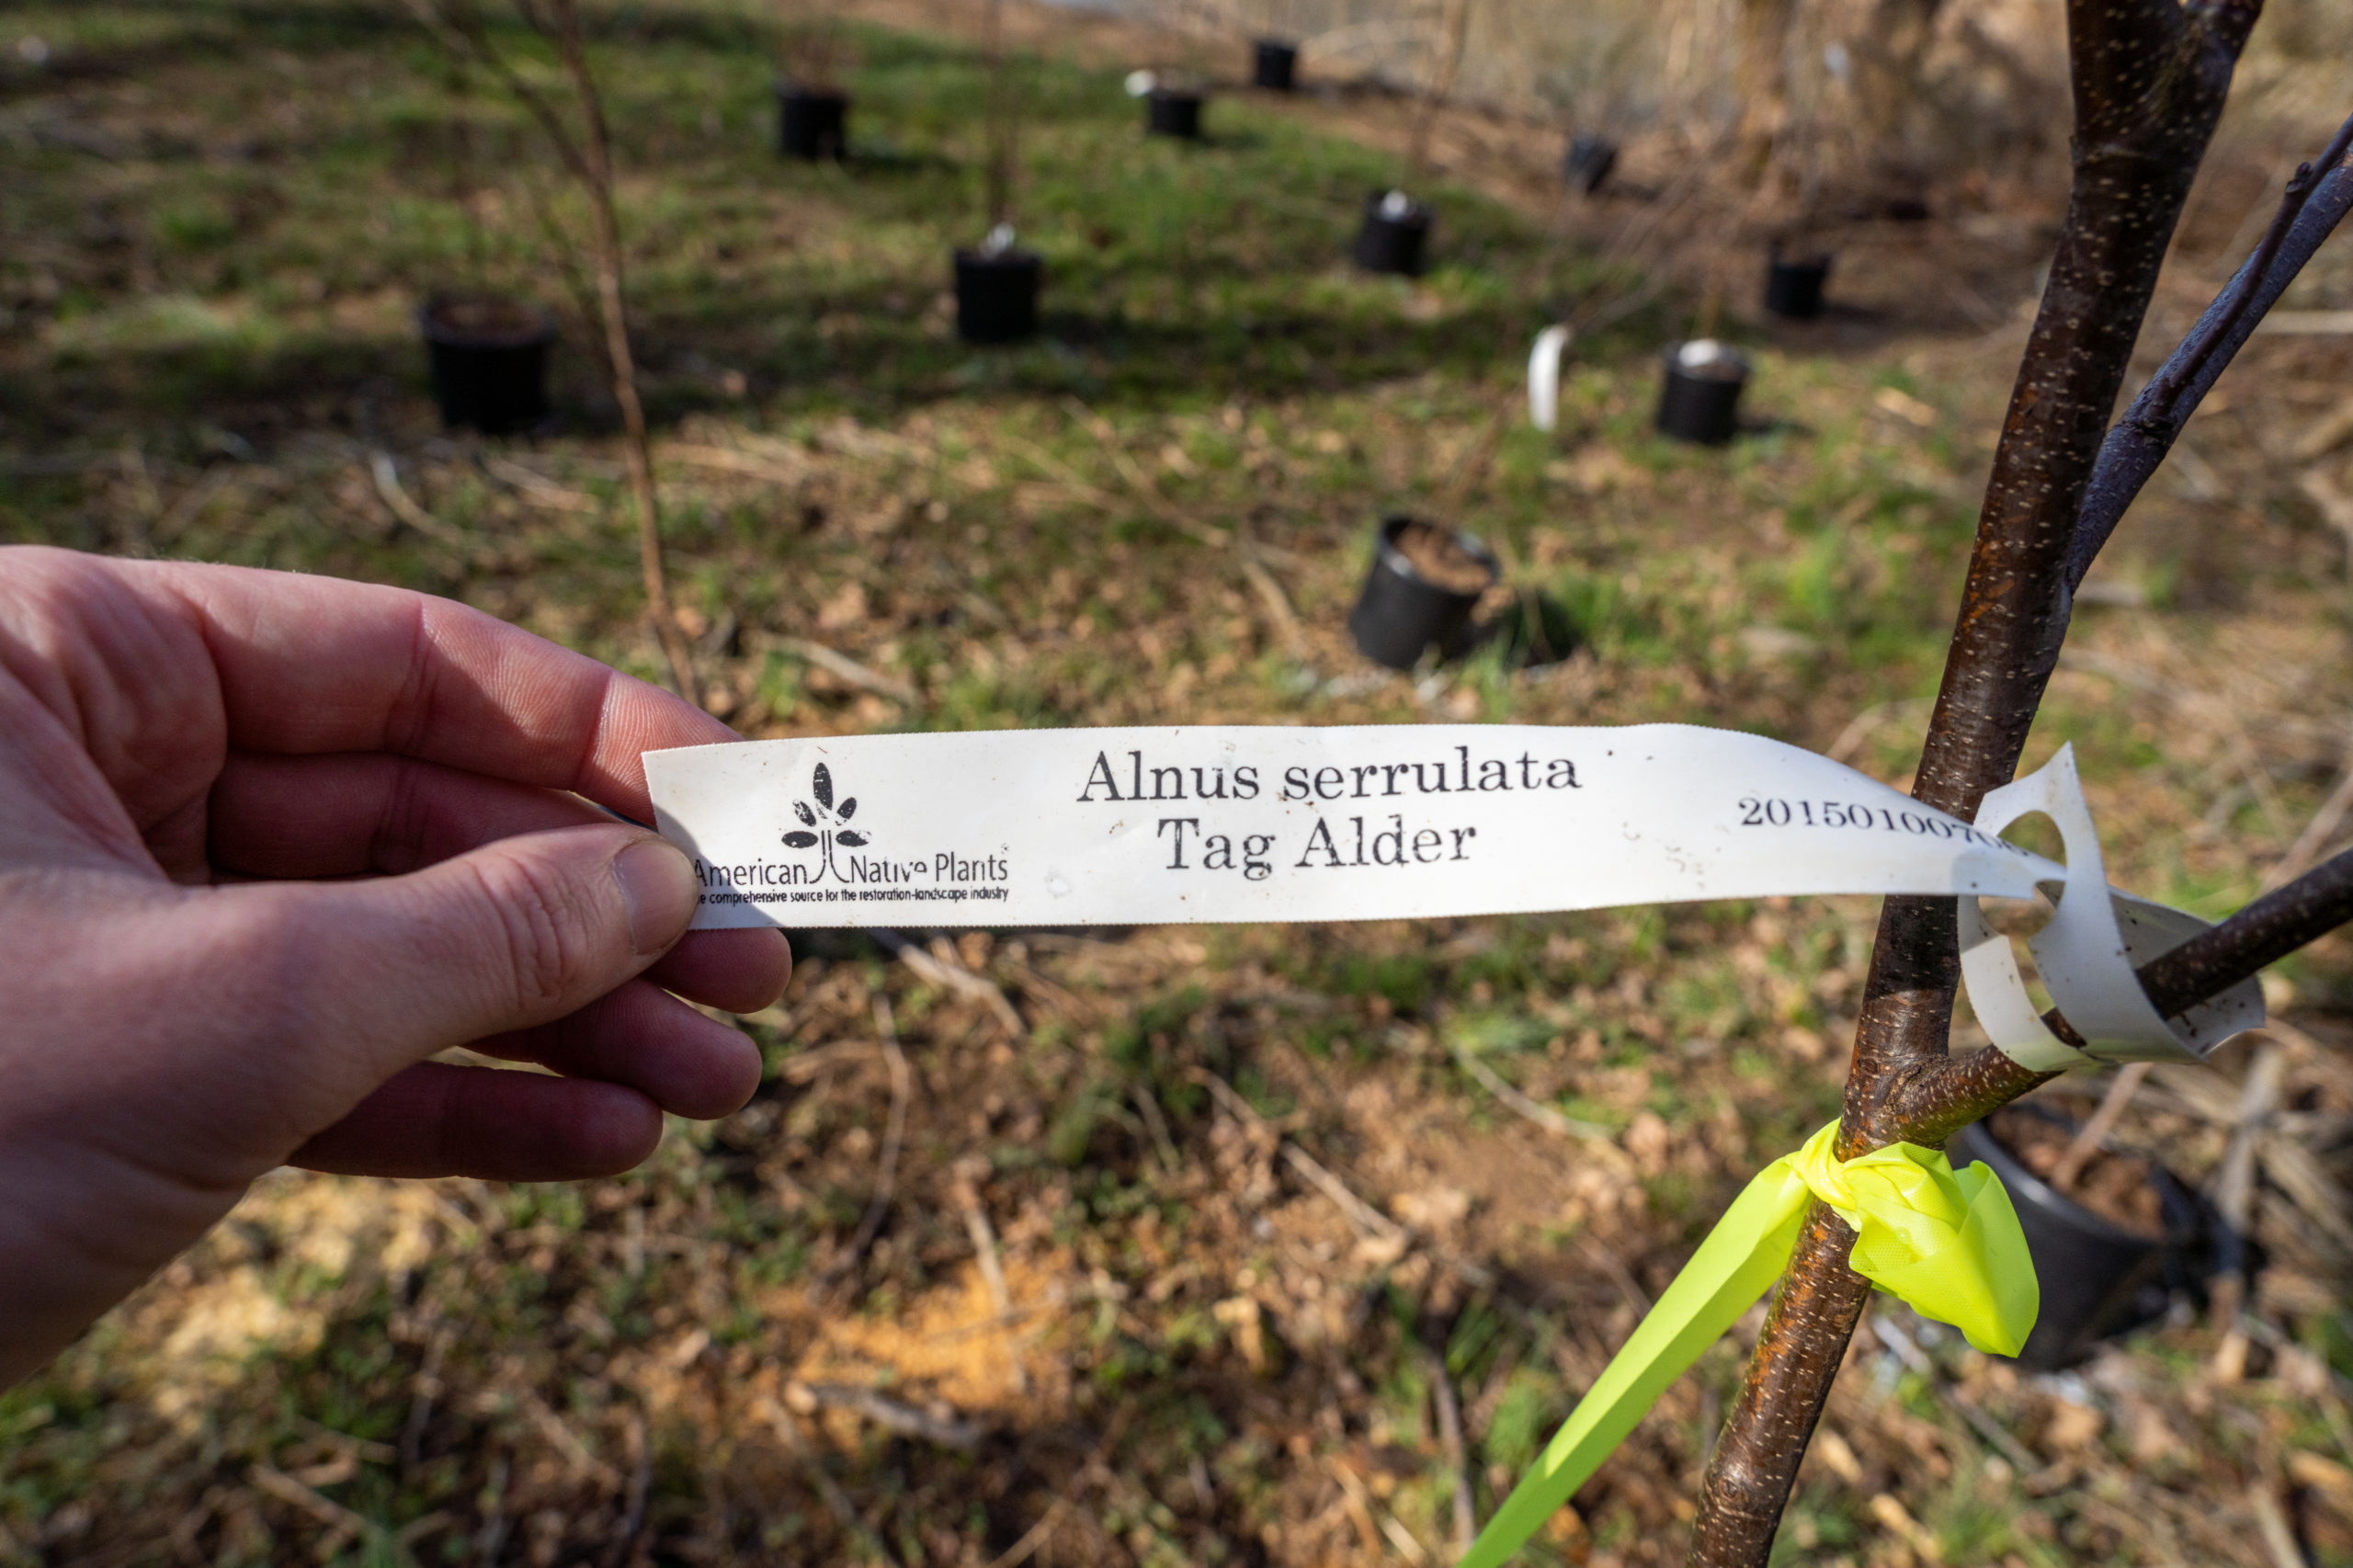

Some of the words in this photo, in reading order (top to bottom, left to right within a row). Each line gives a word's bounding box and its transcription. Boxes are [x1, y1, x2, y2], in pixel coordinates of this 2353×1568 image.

[1076, 750, 1259, 802] Alnus
[1283, 745, 1583, 801] serrulata
[694, 858, 808, 887] American
[850, 855, 927, 883] Native
[935, 851, 1008, 882] Plants
[1157, 817, 1277, 881] Tag
[1295, 814, 1477, 869] Alder
[709, 889, 787, 907] comprehensive
[790, 891, 823, 903] source
[825, 889, 839, 903] for
[841, 888, 857, 902] the
[971, 885, 1009, 903] industry
